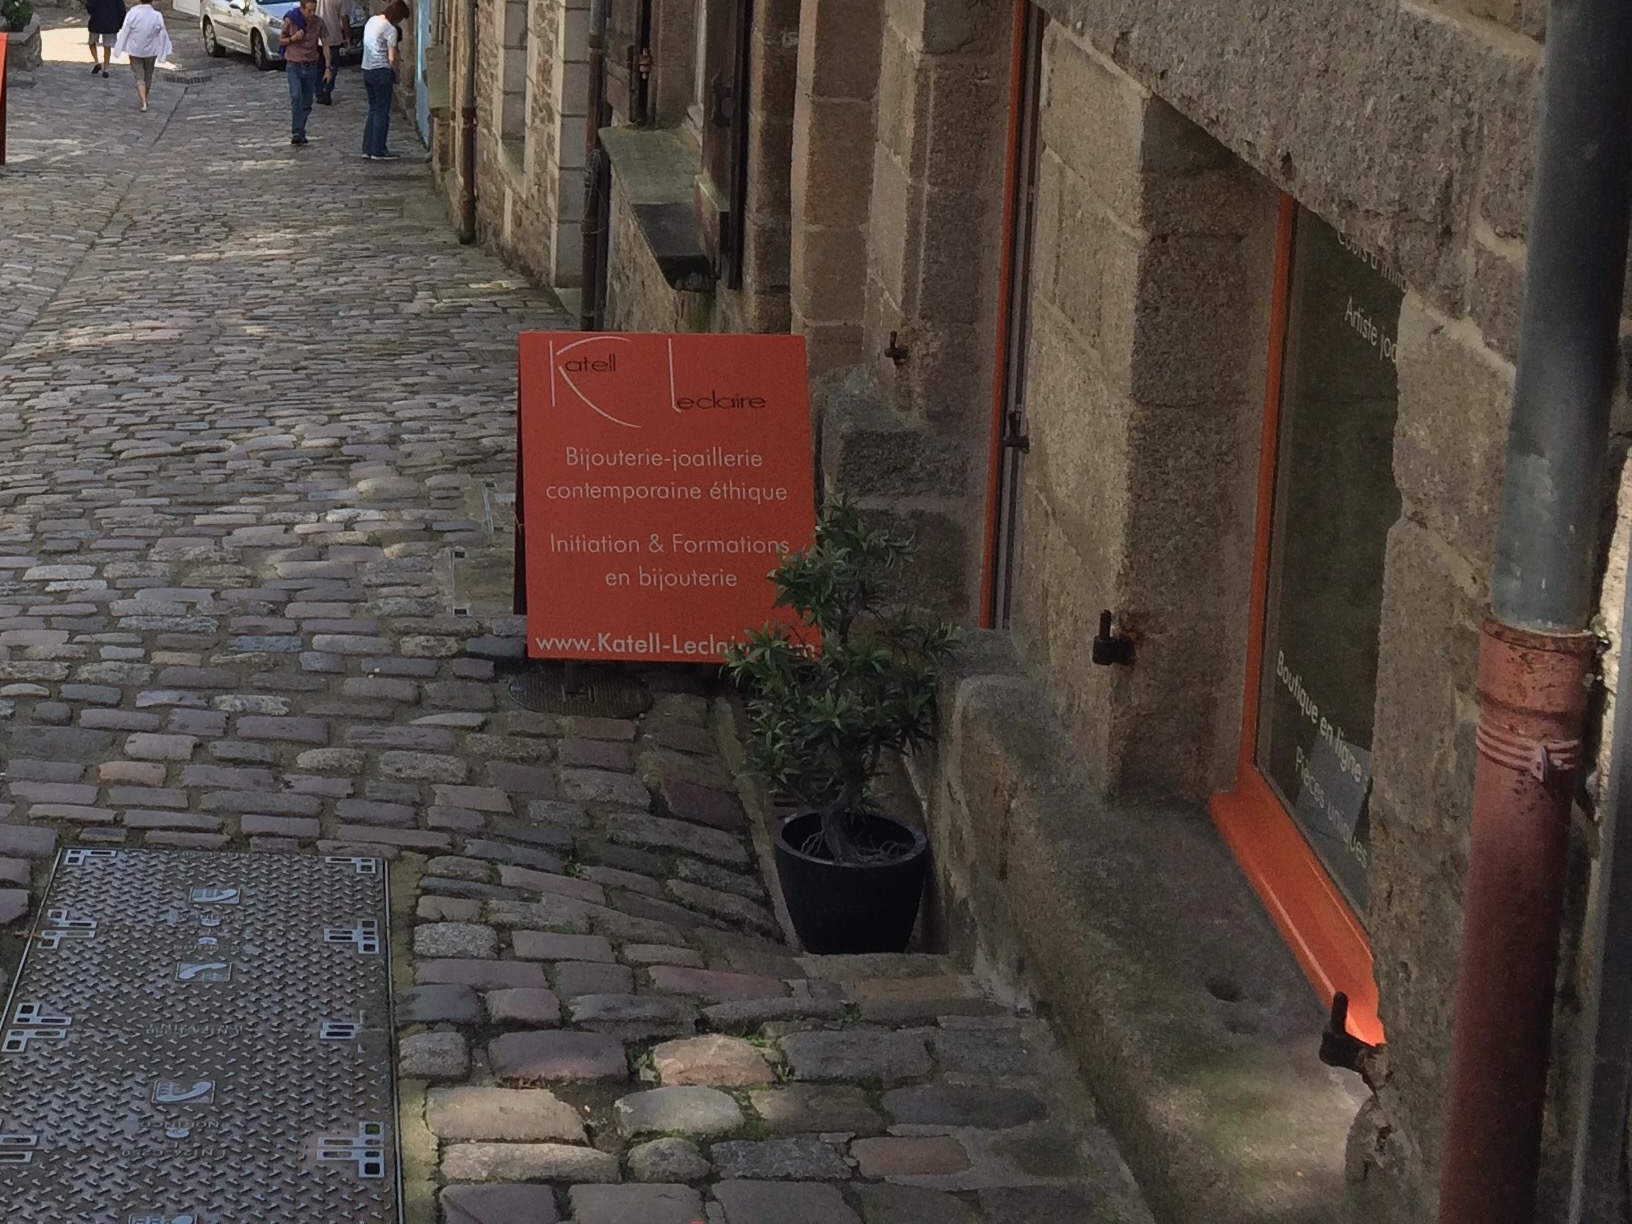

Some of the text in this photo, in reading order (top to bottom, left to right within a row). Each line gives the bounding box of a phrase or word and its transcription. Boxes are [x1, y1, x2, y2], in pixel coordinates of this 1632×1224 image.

[1344, 295, 1378, 347] Artiste
[548, 334, 641, 428] Katell
[668, 337, 766, 413] Leclaire
[565, 446, 764, 471] Bijouterie-joaillerie
[545, 481, 788, 504] contemporaine éthique
[550, 533, 790, 555] Initiation & Formations
[604, 565, 738, 591] en bijouterie
[1276, 649, 1362, 783] Boutique en ligne
[1295, 745, 1368, 869] Pièces uniques
